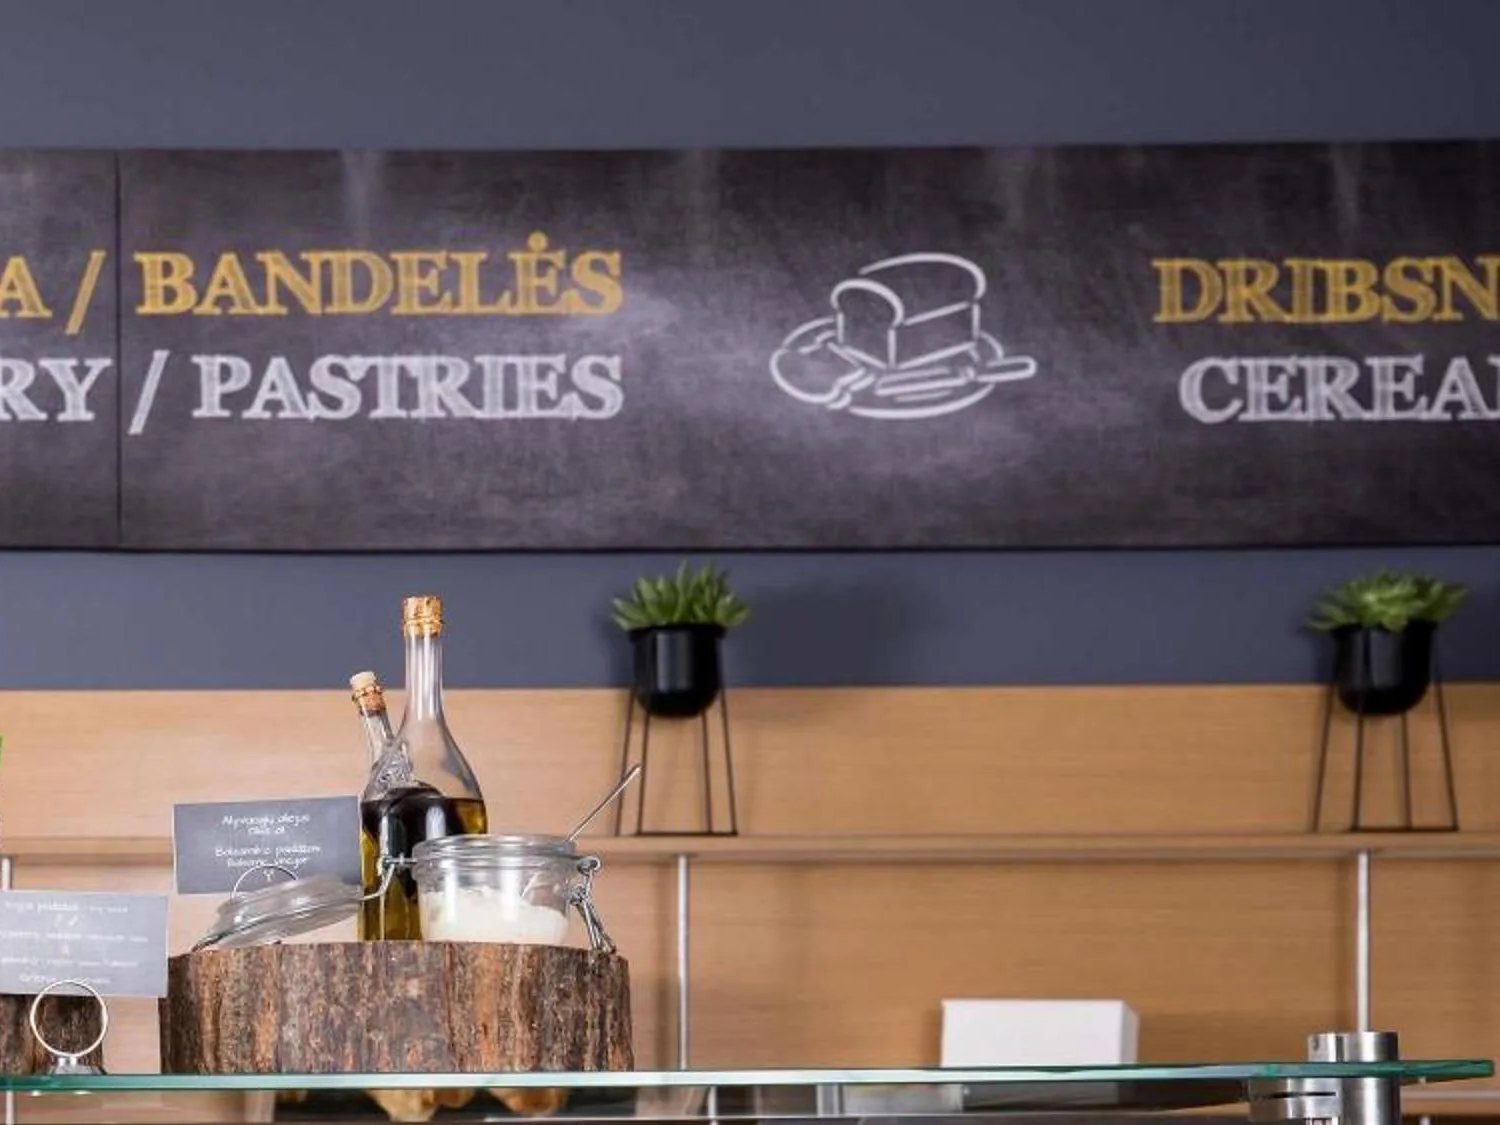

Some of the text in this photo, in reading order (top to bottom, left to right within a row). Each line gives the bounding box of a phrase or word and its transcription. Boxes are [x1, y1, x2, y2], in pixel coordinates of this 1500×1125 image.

[65, 250, 106, 335] /
[133, 231, 624, 317] BANDELĖS
[1151, 256, 1500, 324] DRIBSN
[128, 350, 169, 434] /
[191, 354, 624, 421] PASTRIES
